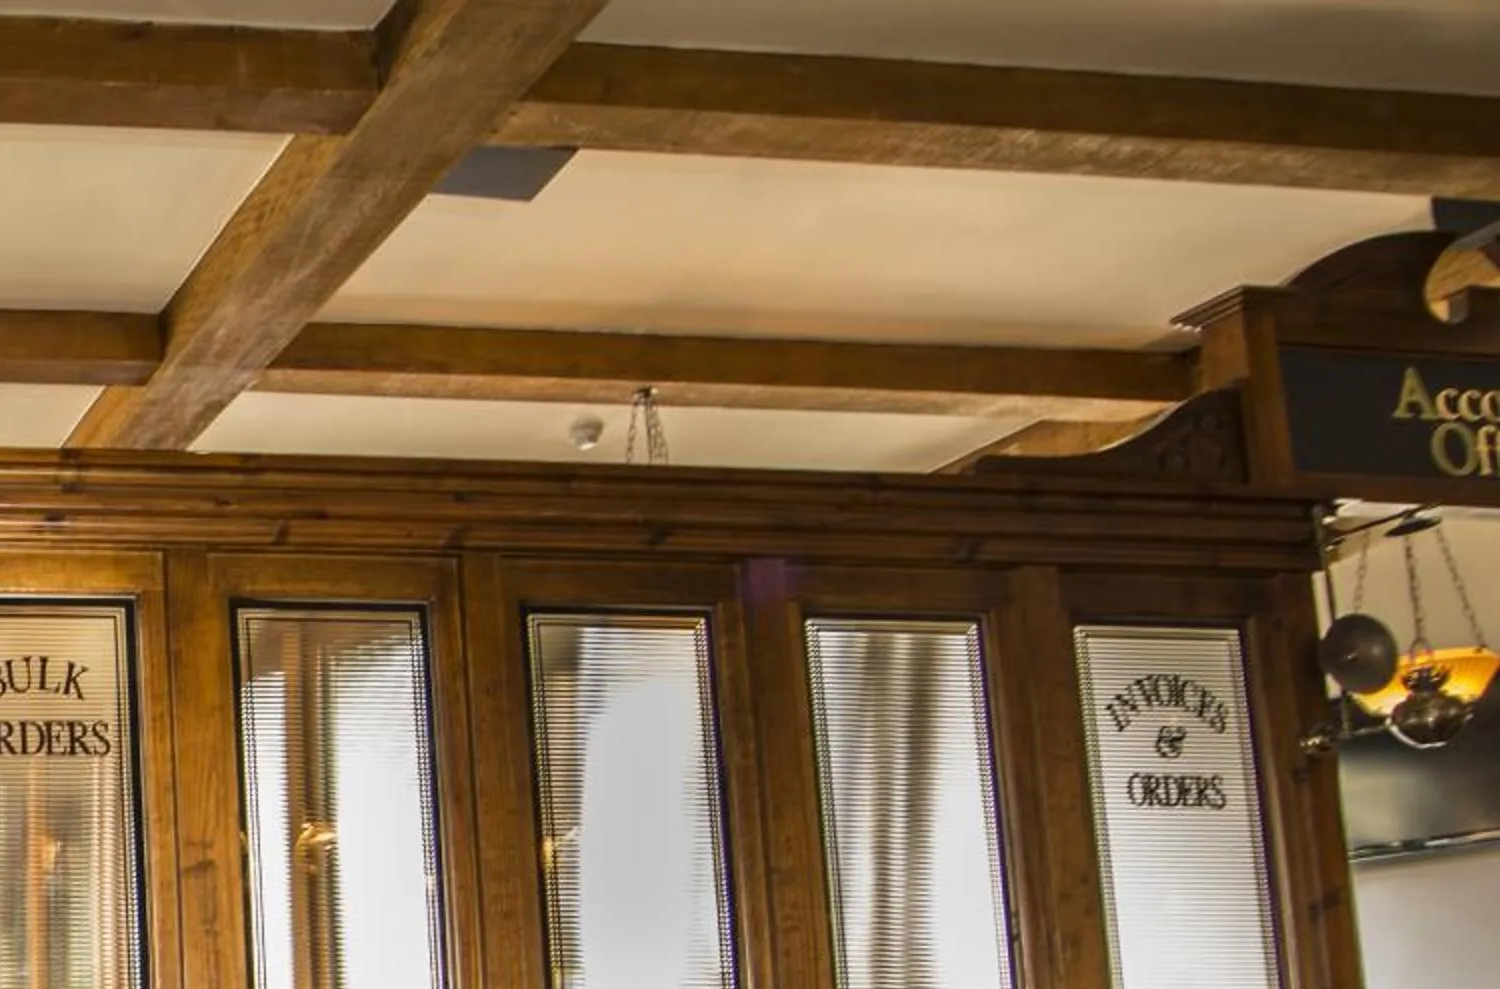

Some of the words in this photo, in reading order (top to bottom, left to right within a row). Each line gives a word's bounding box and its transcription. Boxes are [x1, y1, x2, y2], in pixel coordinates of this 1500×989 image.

[1430, 422, 1500, 477] Of
[1106, 674, 1226, 733] INVOICES
[1155, 725, 1187, 758] &
[1126, 772, 1227, 810] ORDERS
